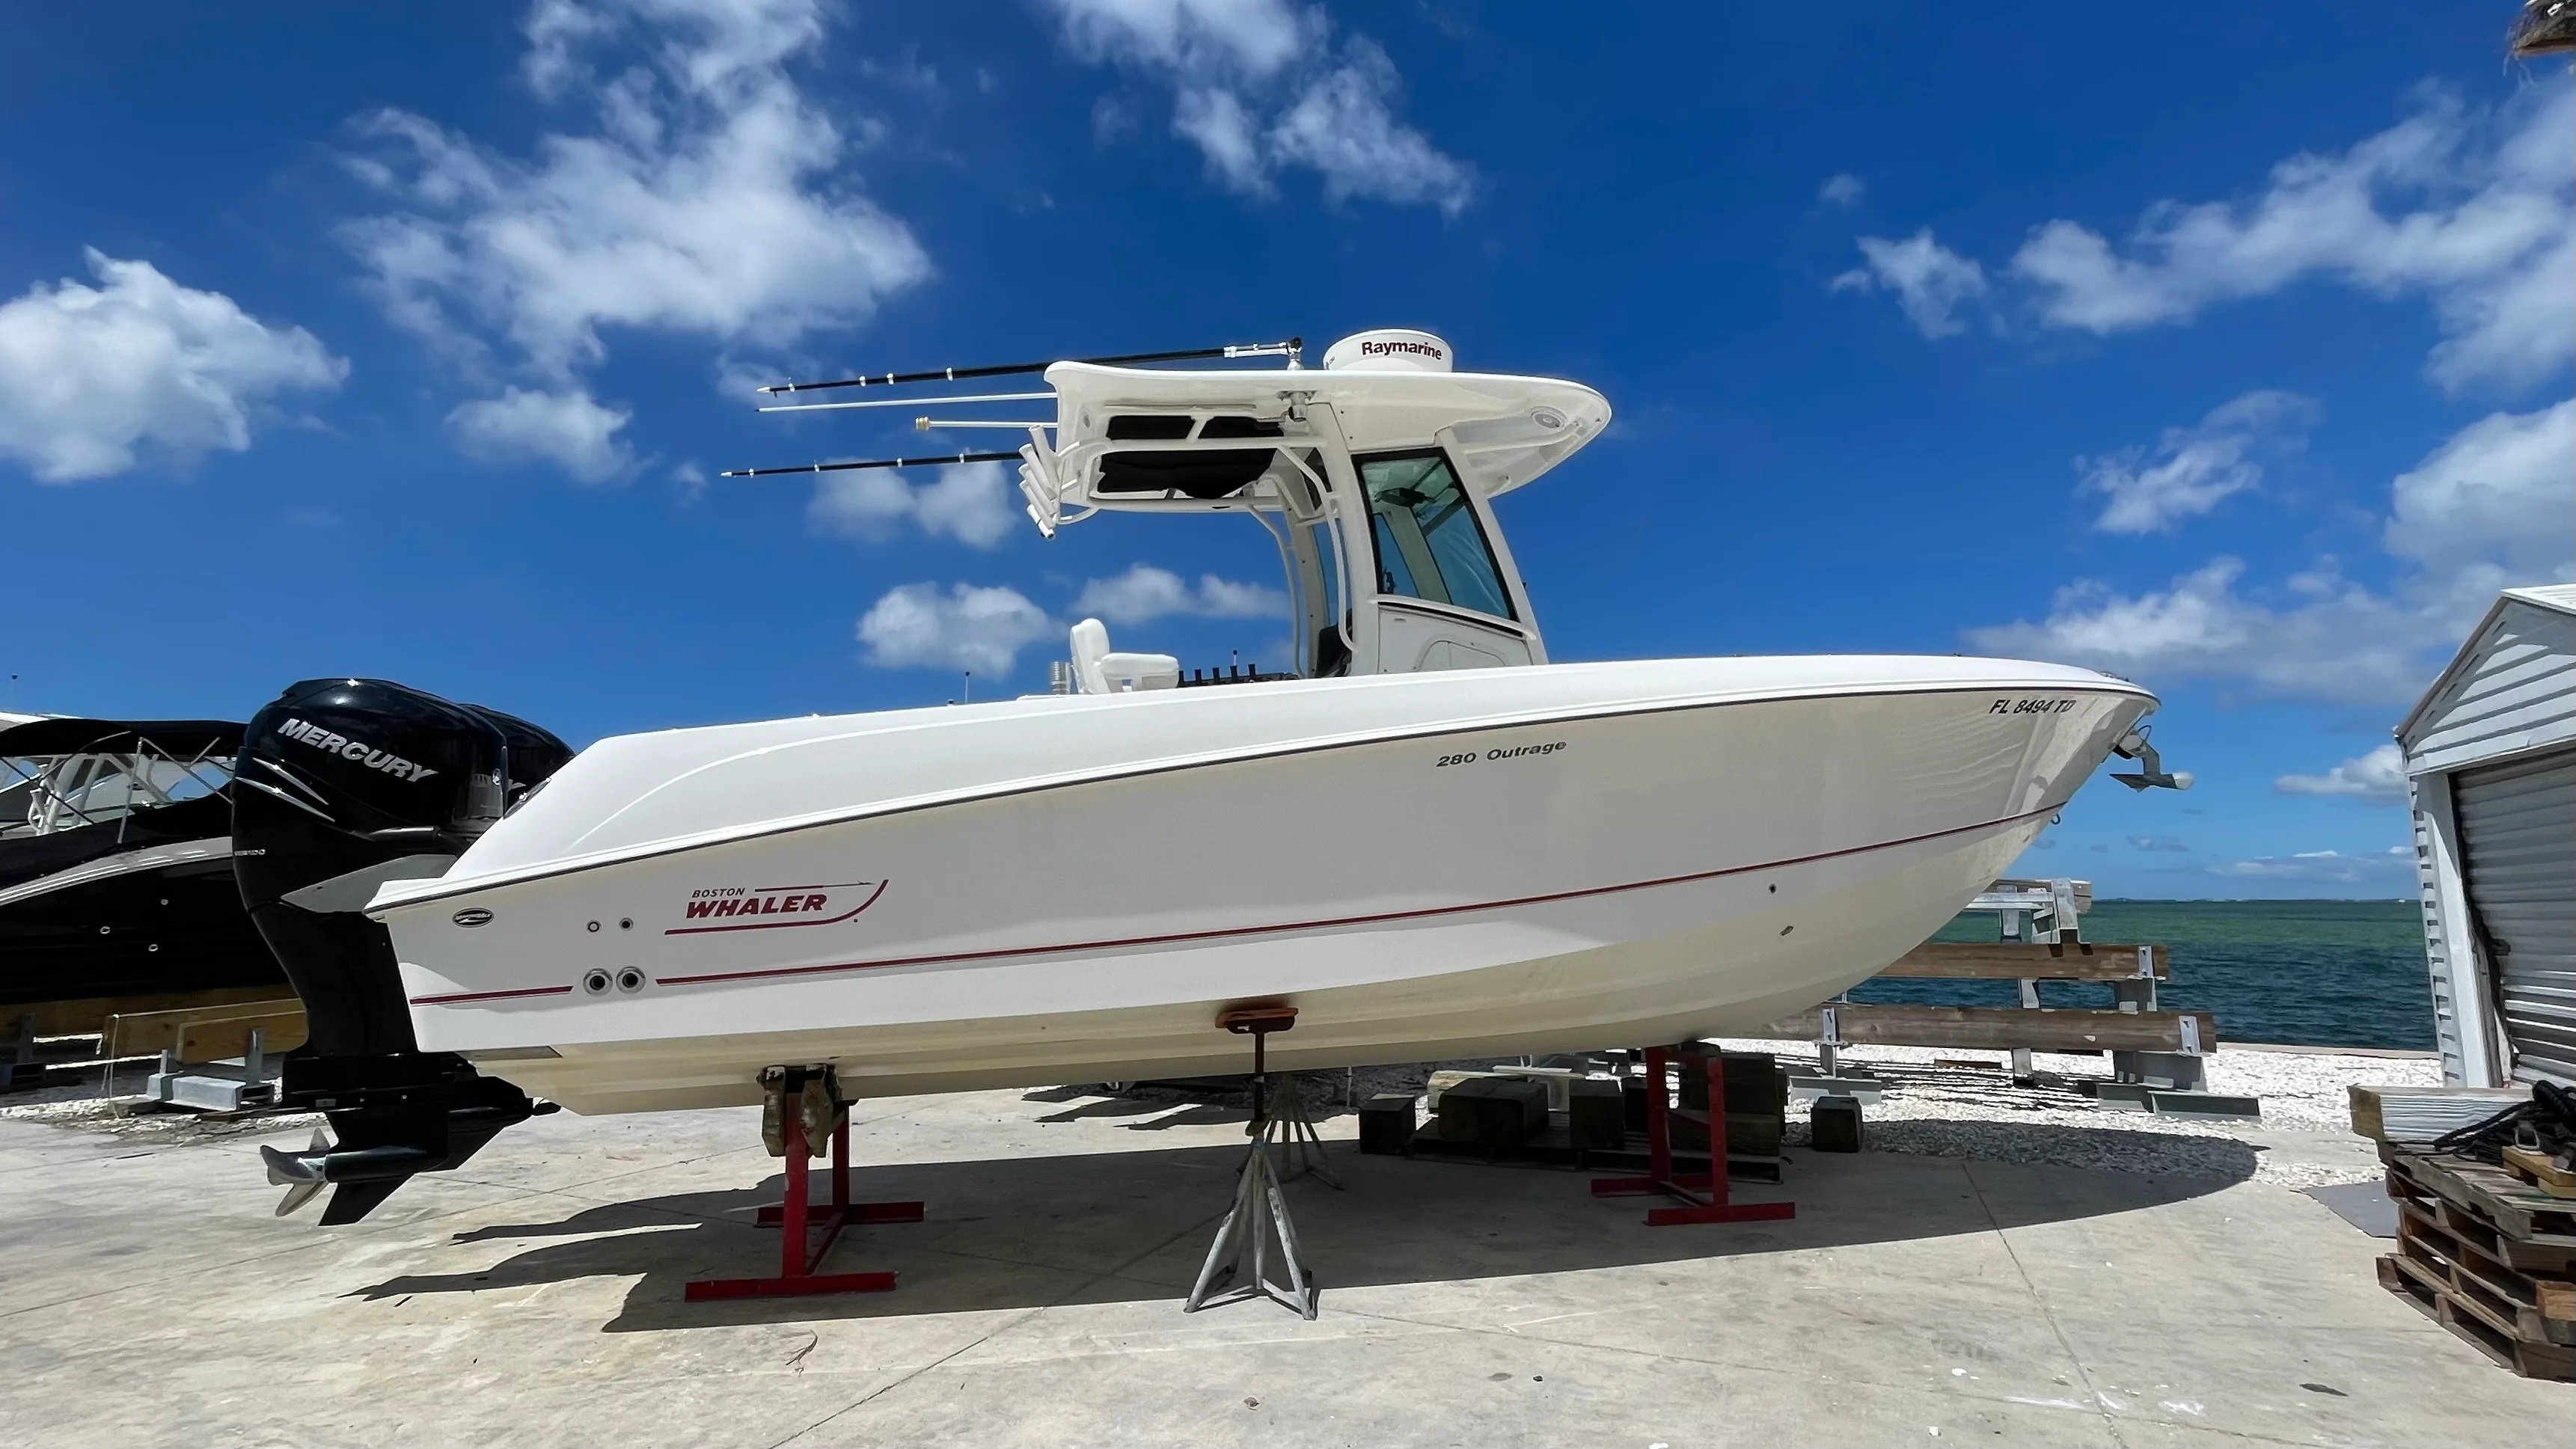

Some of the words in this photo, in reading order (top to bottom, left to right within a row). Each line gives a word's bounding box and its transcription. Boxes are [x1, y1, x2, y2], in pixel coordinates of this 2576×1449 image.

[1362, 341, 1443, 361] Raymarine
[1989, 699, 2011, 714] FL
[2013, 699, 2055, 714] 8494
[2053, 699, 2077, 714] TD
[277, 717, 439, 782] MERCURY
[1436, 752, 1478, 768] 280
[1487, 741, 1567, 761] Outrage
[691, 887, 746, 898] BOSTON
[686, 894, 827, 919] WHALER
